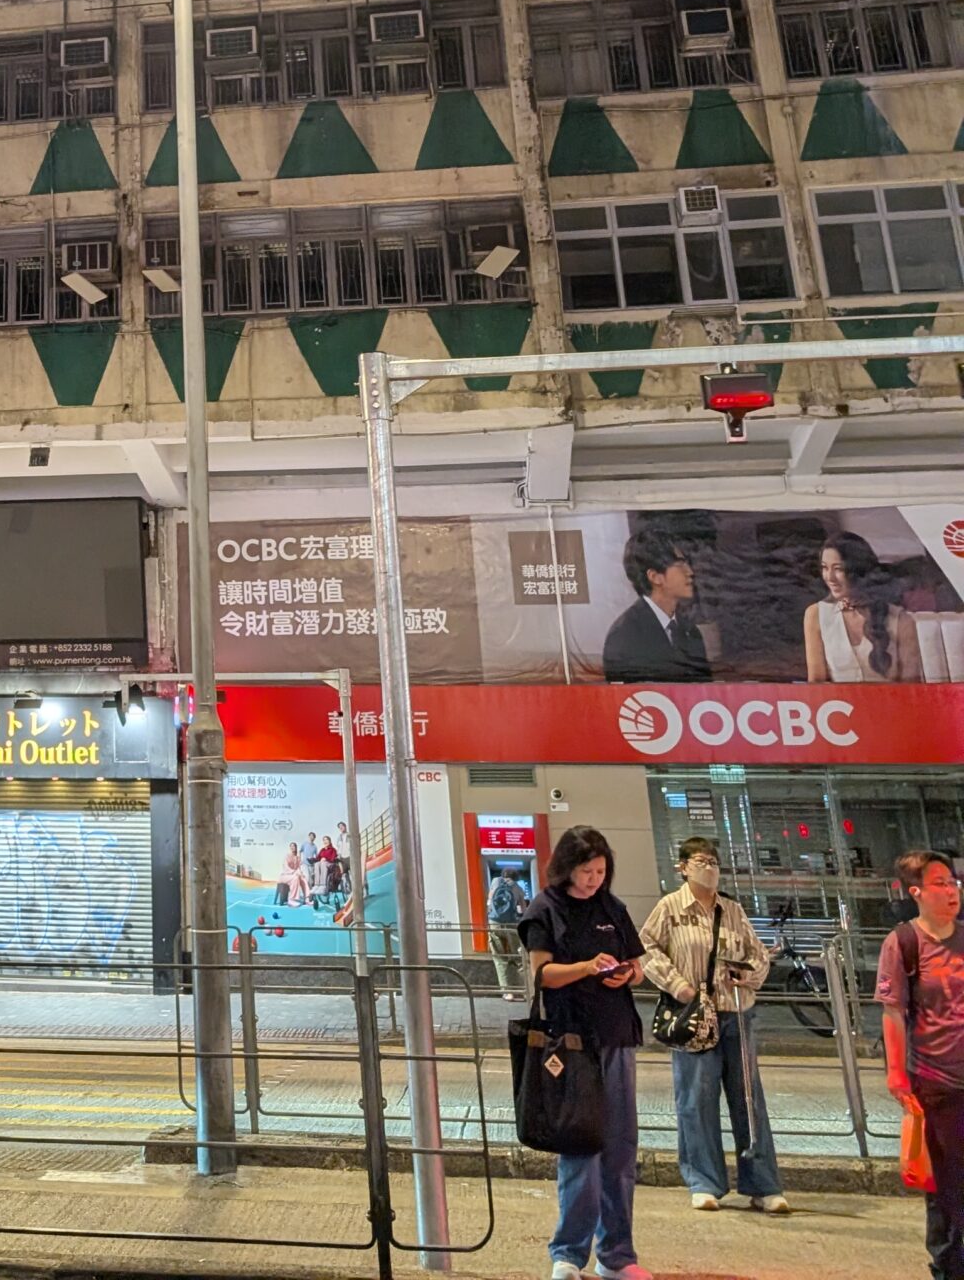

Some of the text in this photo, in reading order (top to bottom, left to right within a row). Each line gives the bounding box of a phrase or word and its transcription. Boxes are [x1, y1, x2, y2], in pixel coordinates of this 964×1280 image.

[218, 577, 345, 605] 讓時間增值
[219, 607, 449, 636] 令財富潛力發極致
[689, 700, 860, 747] OCBC
[20, 739, 100, 764] Outlet
[417, 771, 442, 782] CBC
